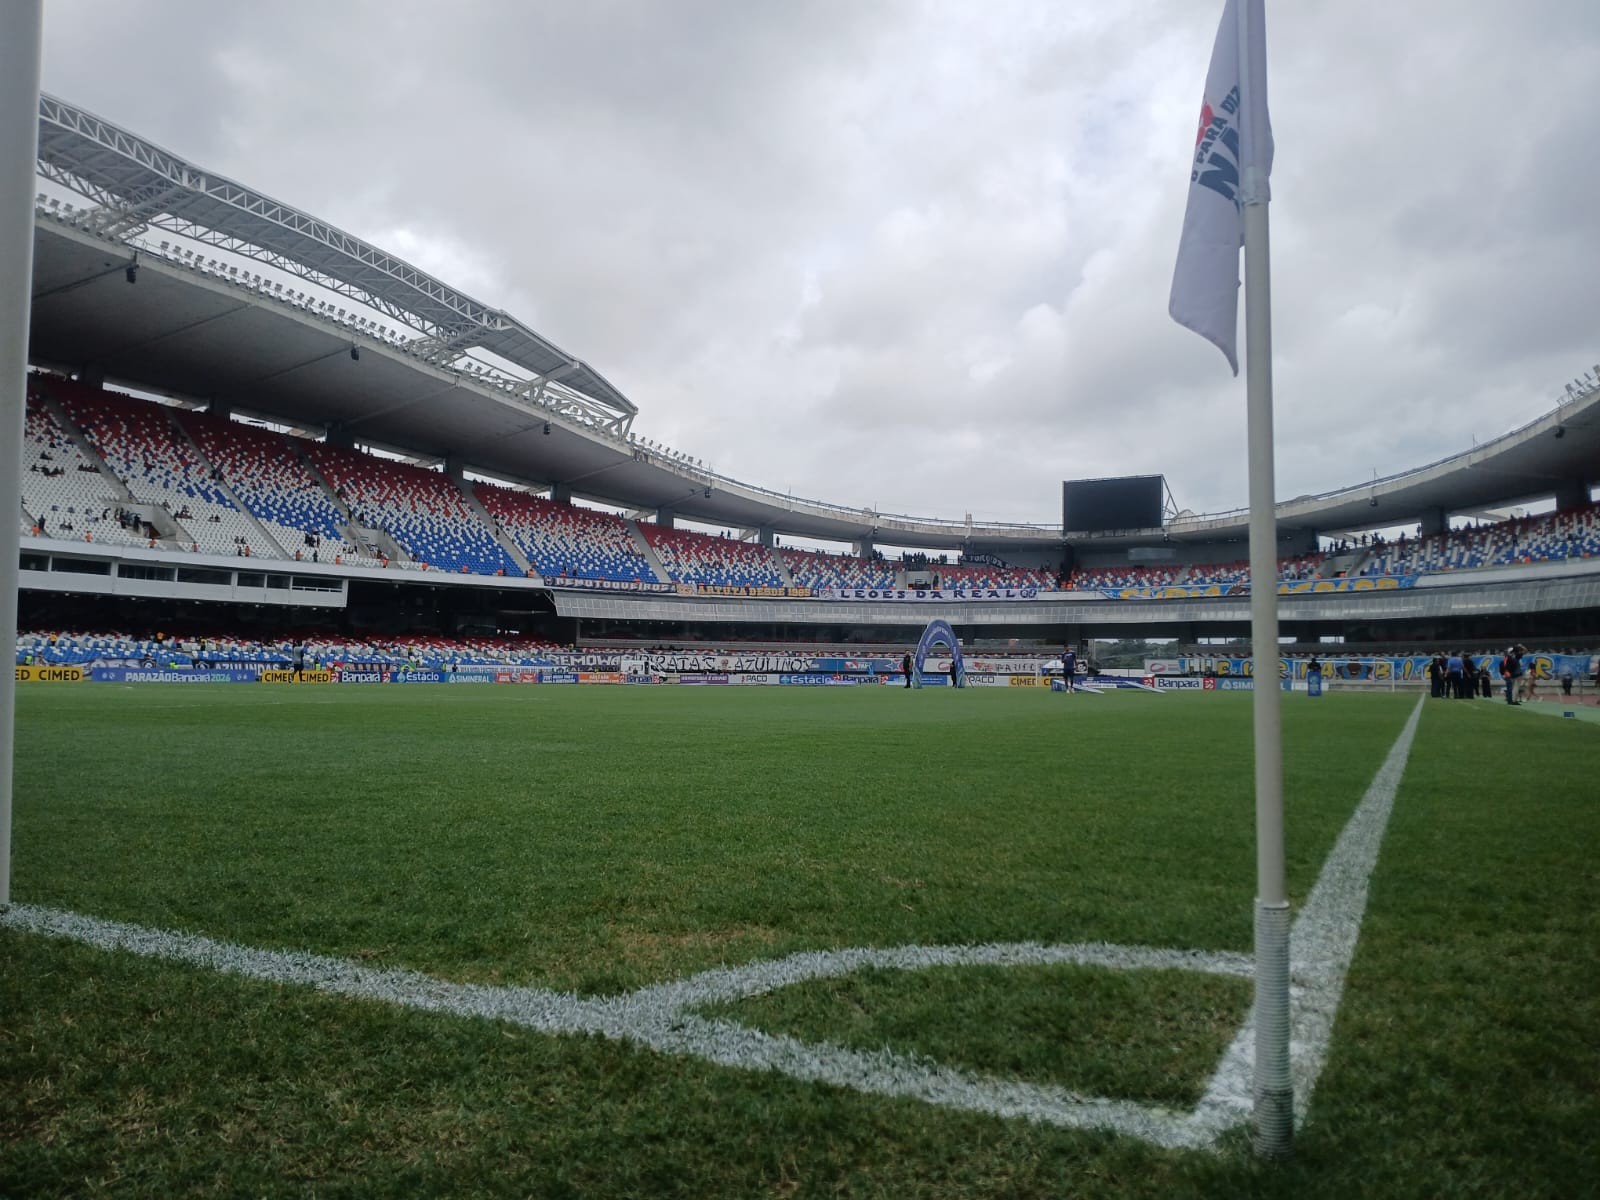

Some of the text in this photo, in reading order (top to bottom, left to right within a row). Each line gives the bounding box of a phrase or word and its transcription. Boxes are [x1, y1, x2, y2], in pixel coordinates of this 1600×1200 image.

[953, 590, 1015, 598] REAL
[39, 670, 80, 681] CIMED
[265, 672, 294, 682] CIMED
[302, 673, 329, 682] CIMED
[406, 671, 439, 681] Estácio
[791, 675, 832, 685] Estácio
